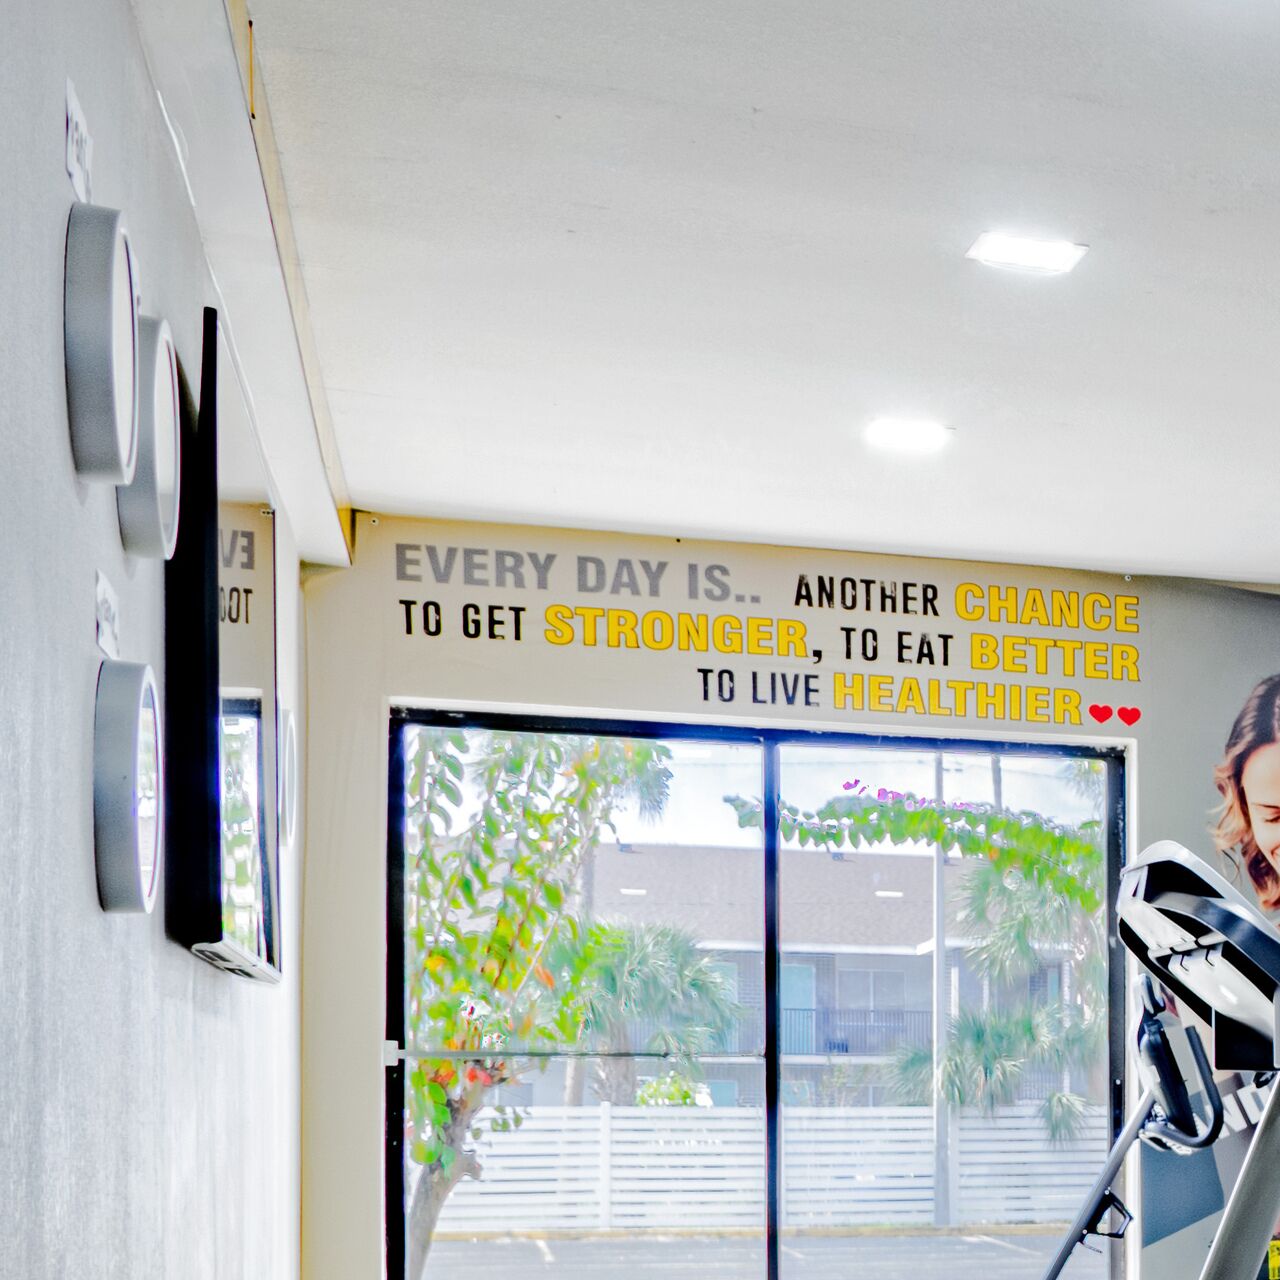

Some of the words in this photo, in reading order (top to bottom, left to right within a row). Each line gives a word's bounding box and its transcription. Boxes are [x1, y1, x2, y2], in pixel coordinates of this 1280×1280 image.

[394, 542, 558, 590] EVERY
[576, 554, 670, 598] DAY
[687, 562, 762, 604] IS..
[793, 573, 940, 617] ANOTHER
[954, 582, 1140, 634] CHANCE
[399, 599, 442, 637] TO
[462, 602, 527, 642] GET
[543, 603, 823, 664] STRONGER,
[839, 626, 879, 662] TO
[898, 632, 954, 667] EAT
[969, 632, 1141, 682] BETTER
[697, 668, 735, 703] TO
[751, 669, 820, 708] LIVE
[833, 672, 1084, 726] HEALTHIER
